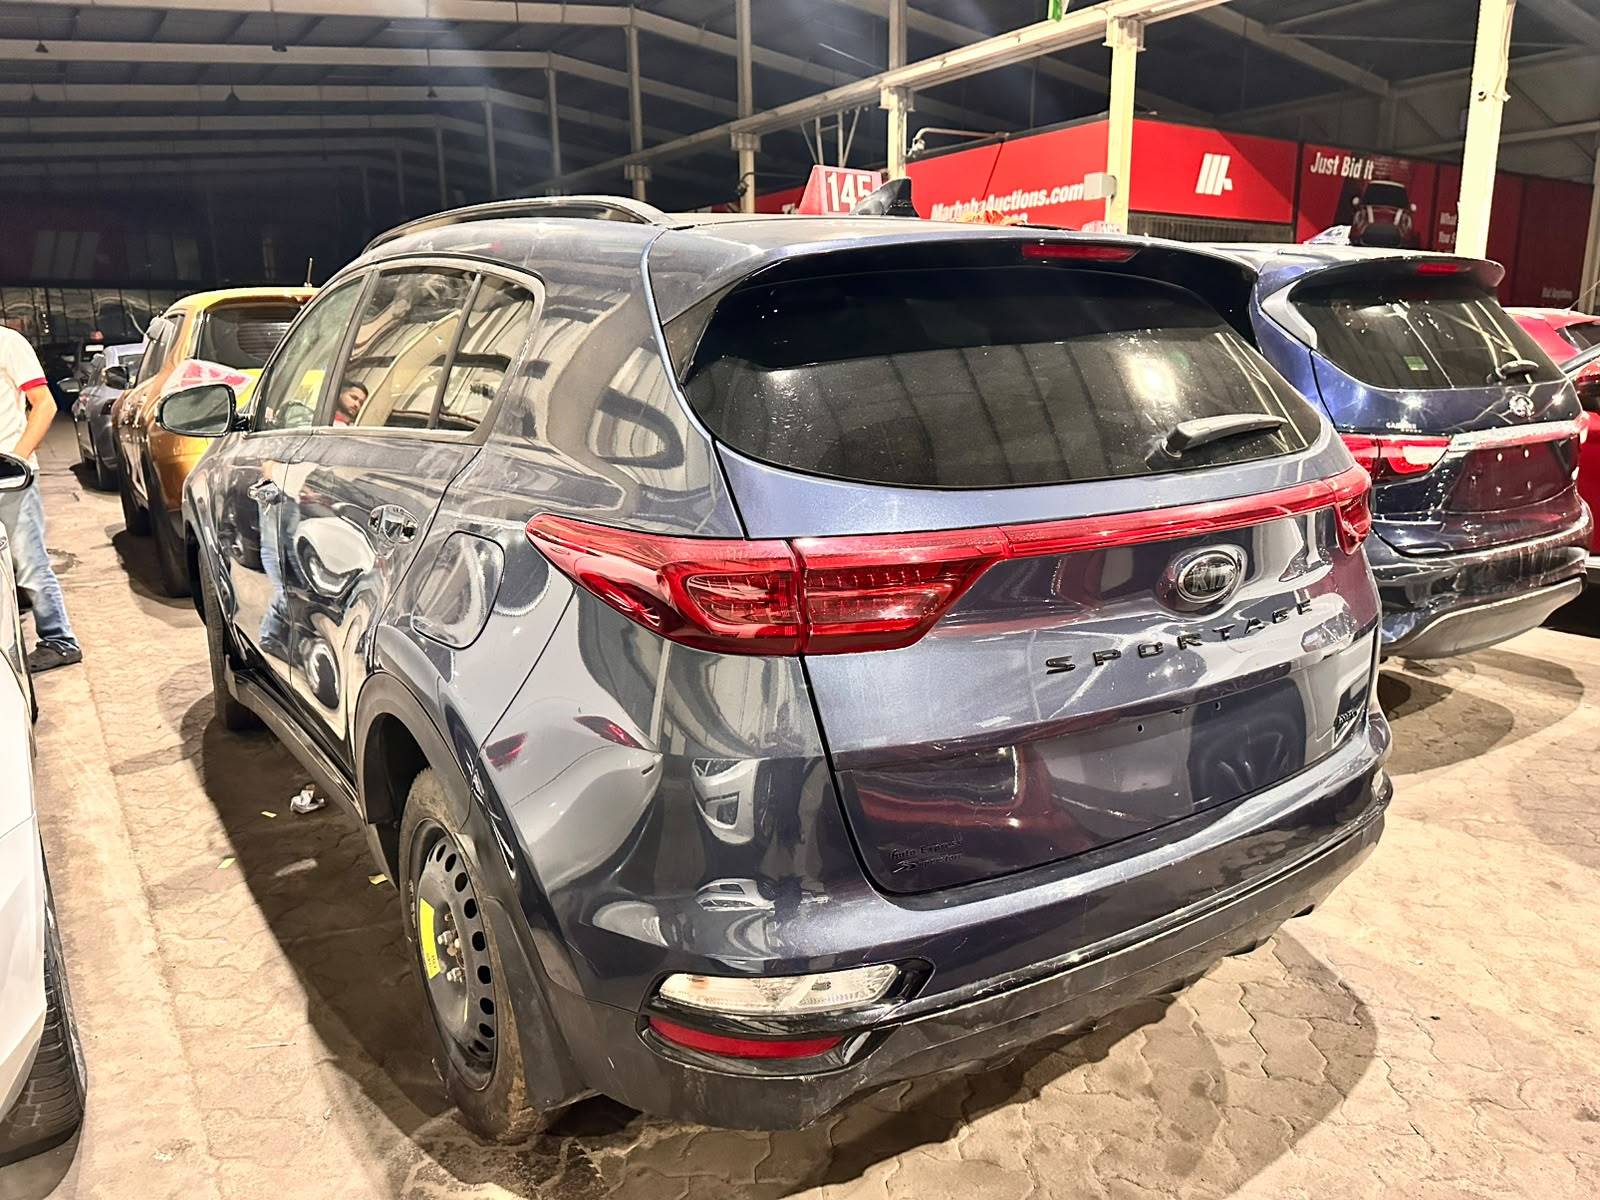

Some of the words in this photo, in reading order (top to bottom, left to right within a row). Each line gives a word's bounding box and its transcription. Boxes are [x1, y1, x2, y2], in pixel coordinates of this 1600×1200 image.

[1310, 152, 1340, 175] Just
[1341, 156, 1365, 179] Bid
[1364, 159, 1375, 181] It
[827, 172, 873, 214] 145
[1046, 597, 1314, 675] SPORTAGE
